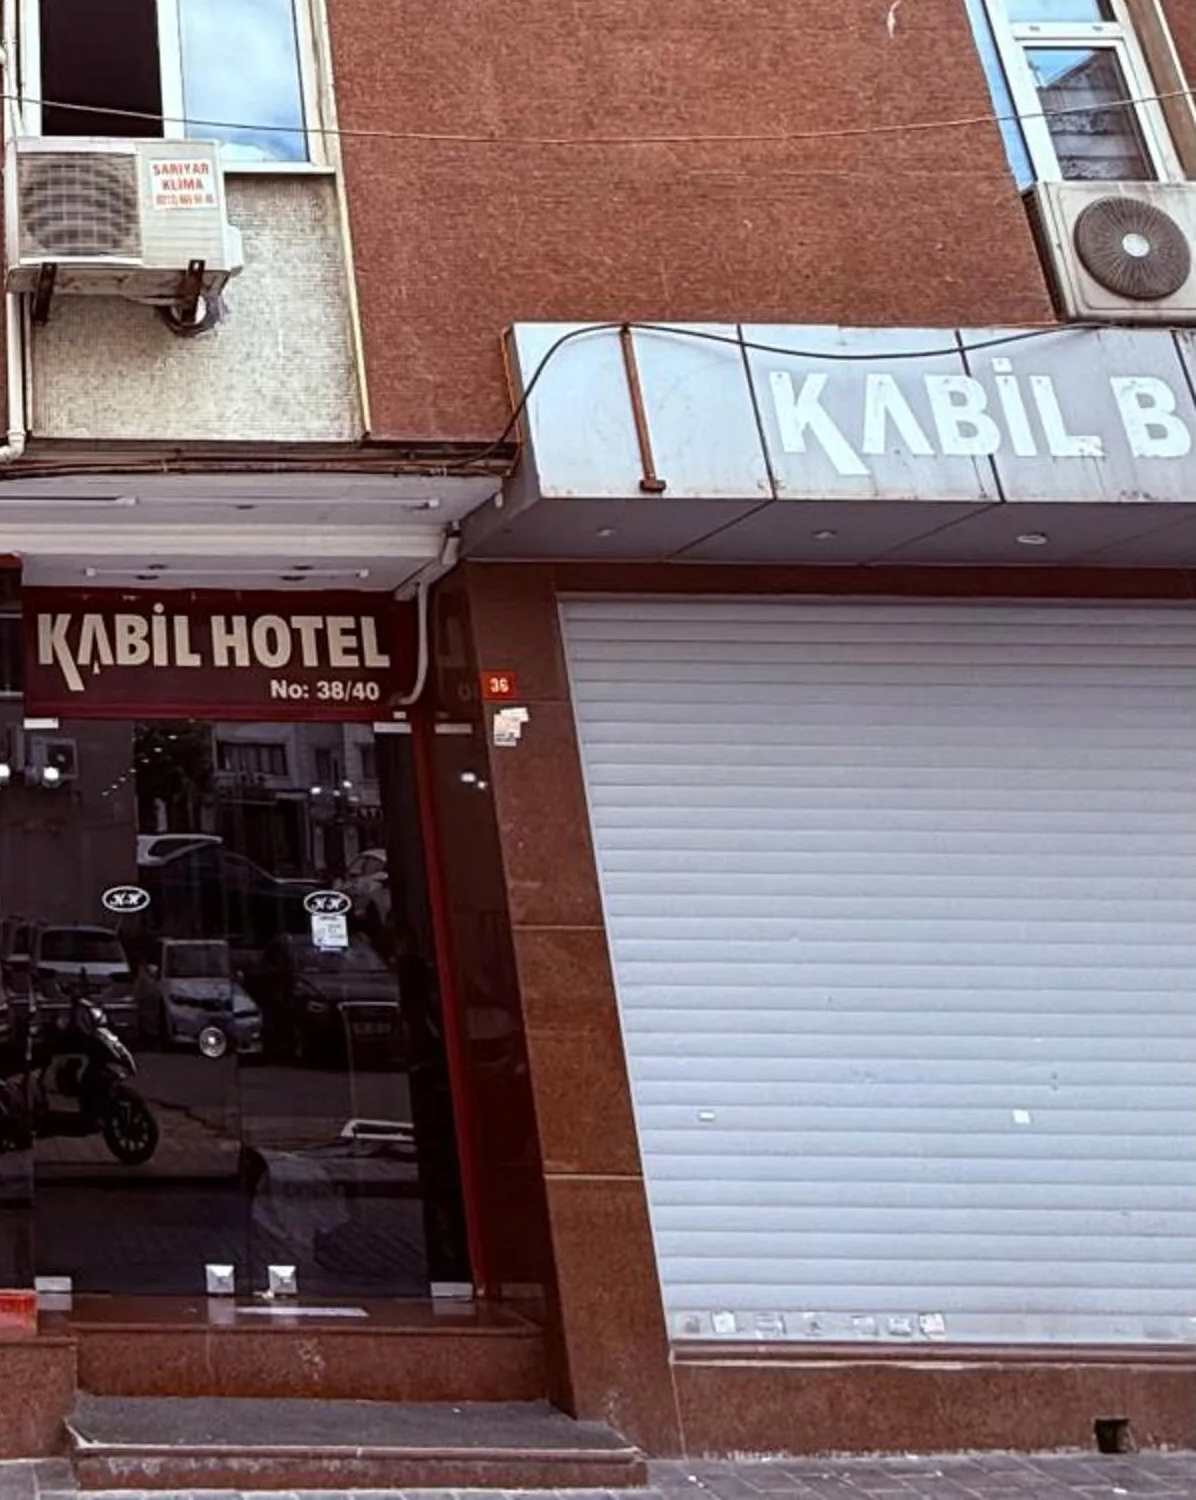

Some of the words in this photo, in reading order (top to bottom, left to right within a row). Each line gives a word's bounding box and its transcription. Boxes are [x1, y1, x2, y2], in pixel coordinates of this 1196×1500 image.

[769, 357, 1107, 476] KABİL
[37, 602, 202, 691] KABİL
[210, 614, 391, 668] HOTEL
[270, 679, 309, 699] No:
[317, 681, 380, 701] 38/40
